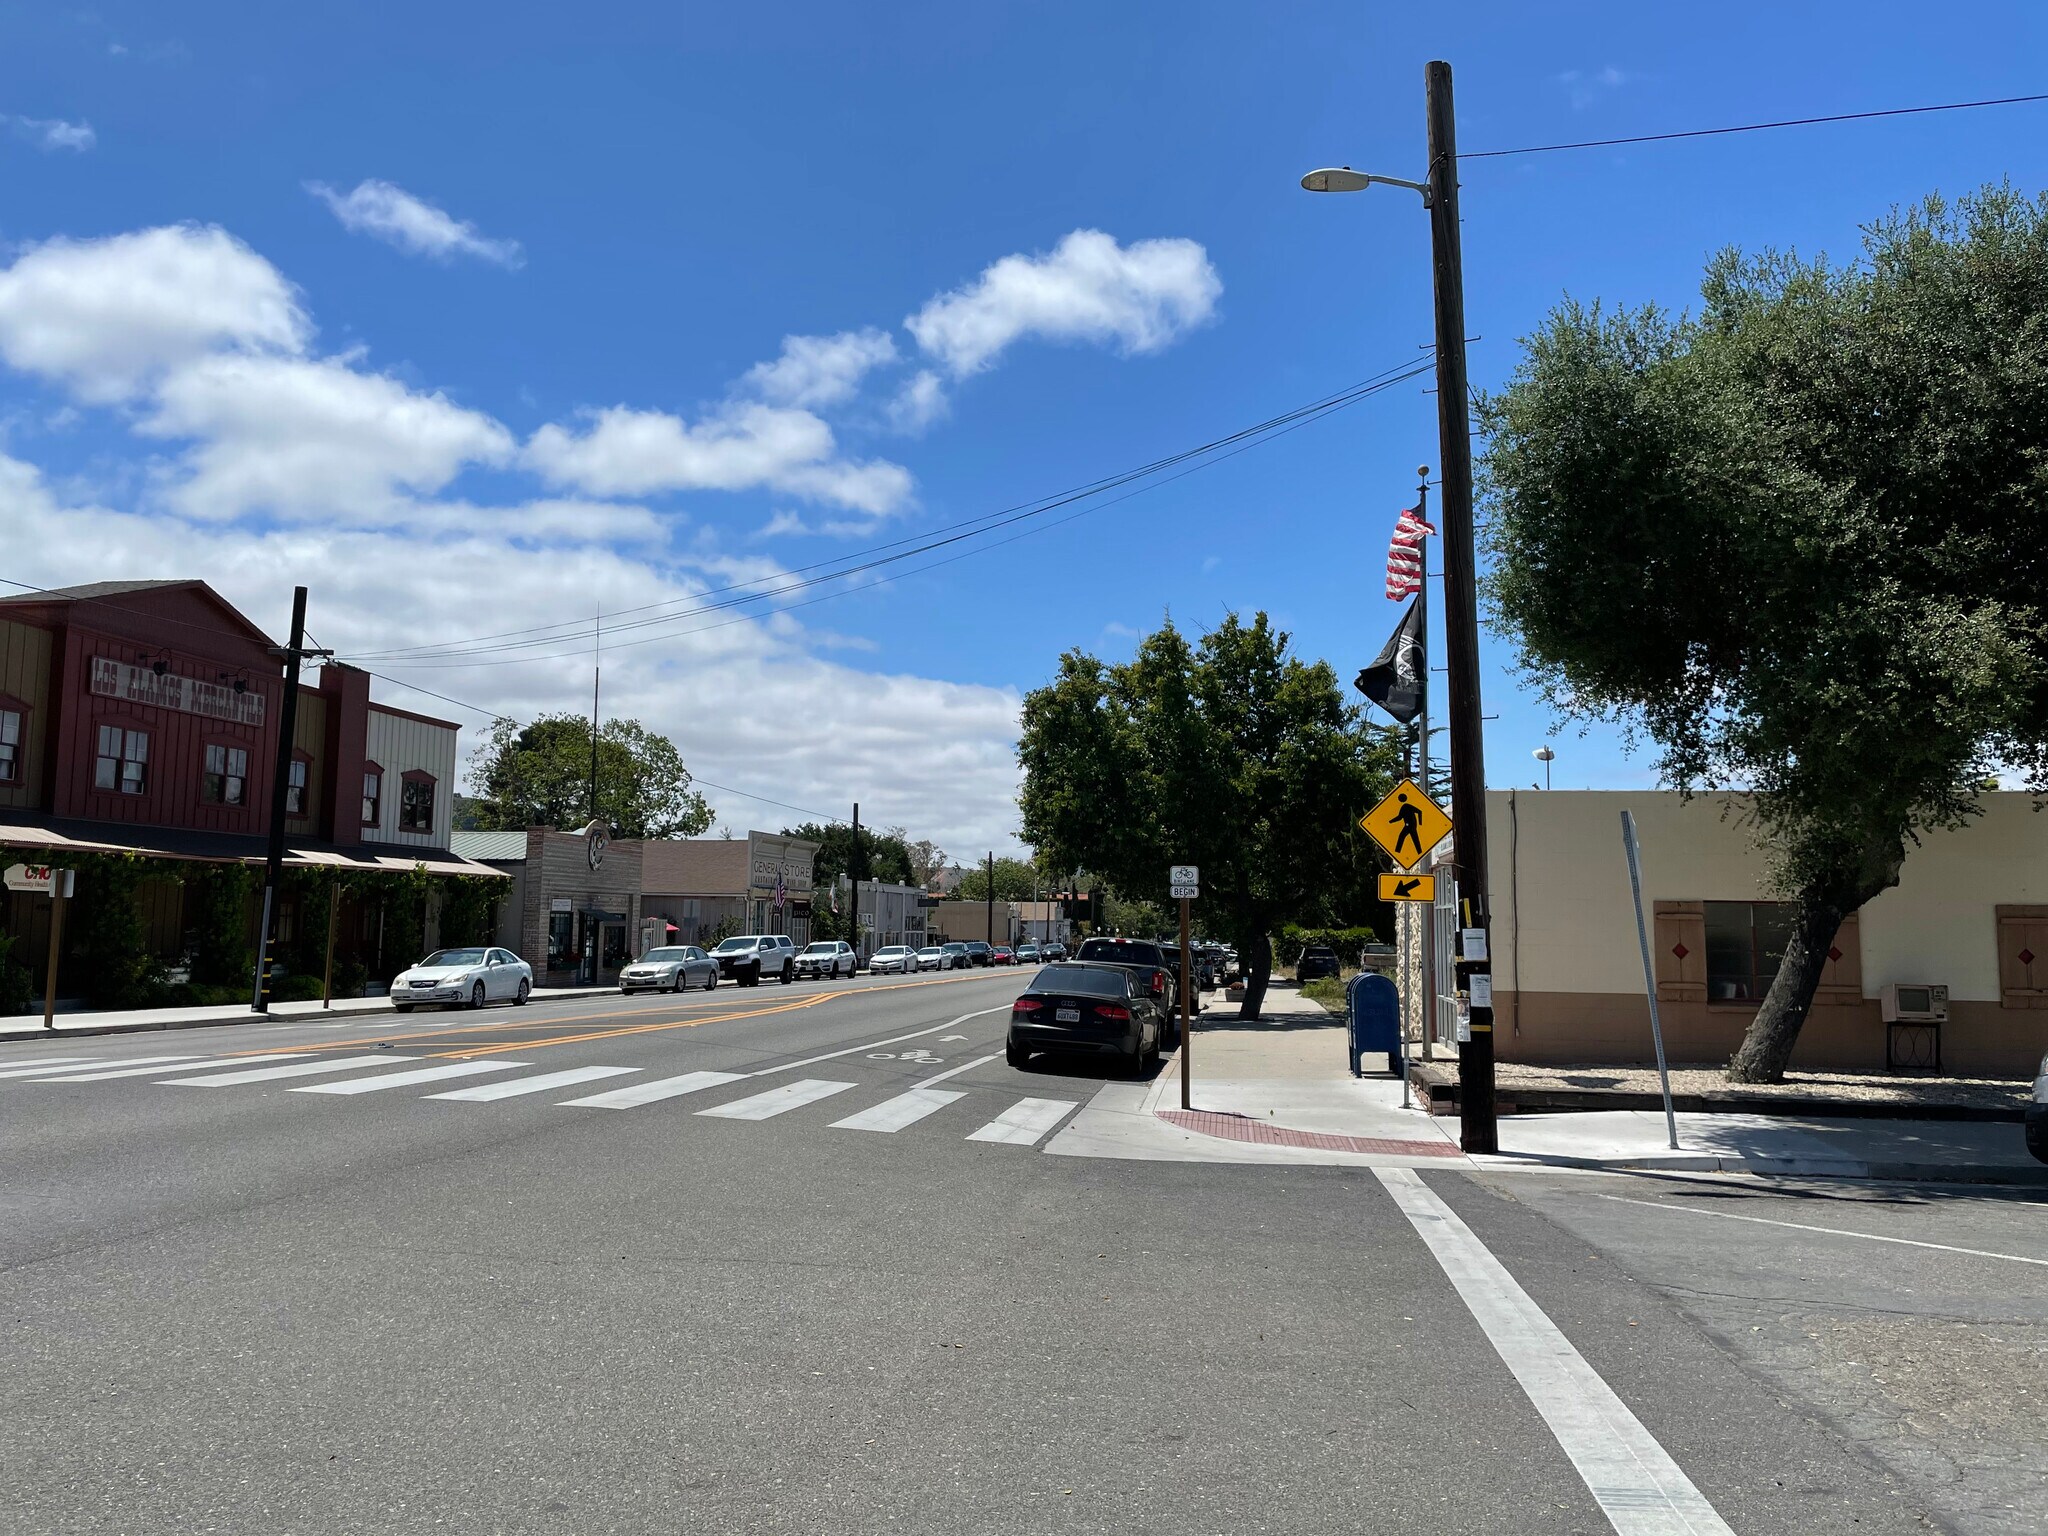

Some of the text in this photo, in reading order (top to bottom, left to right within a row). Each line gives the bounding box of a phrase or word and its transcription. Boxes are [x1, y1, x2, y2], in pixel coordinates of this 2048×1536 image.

[93, 657, 264, 726] LOS ALAMOS MERCANTILE
[784, 864, 811, 878] STORE
[9, 880, 34, 888] Community
[1174, 888, 1195, 896] BEGIN
